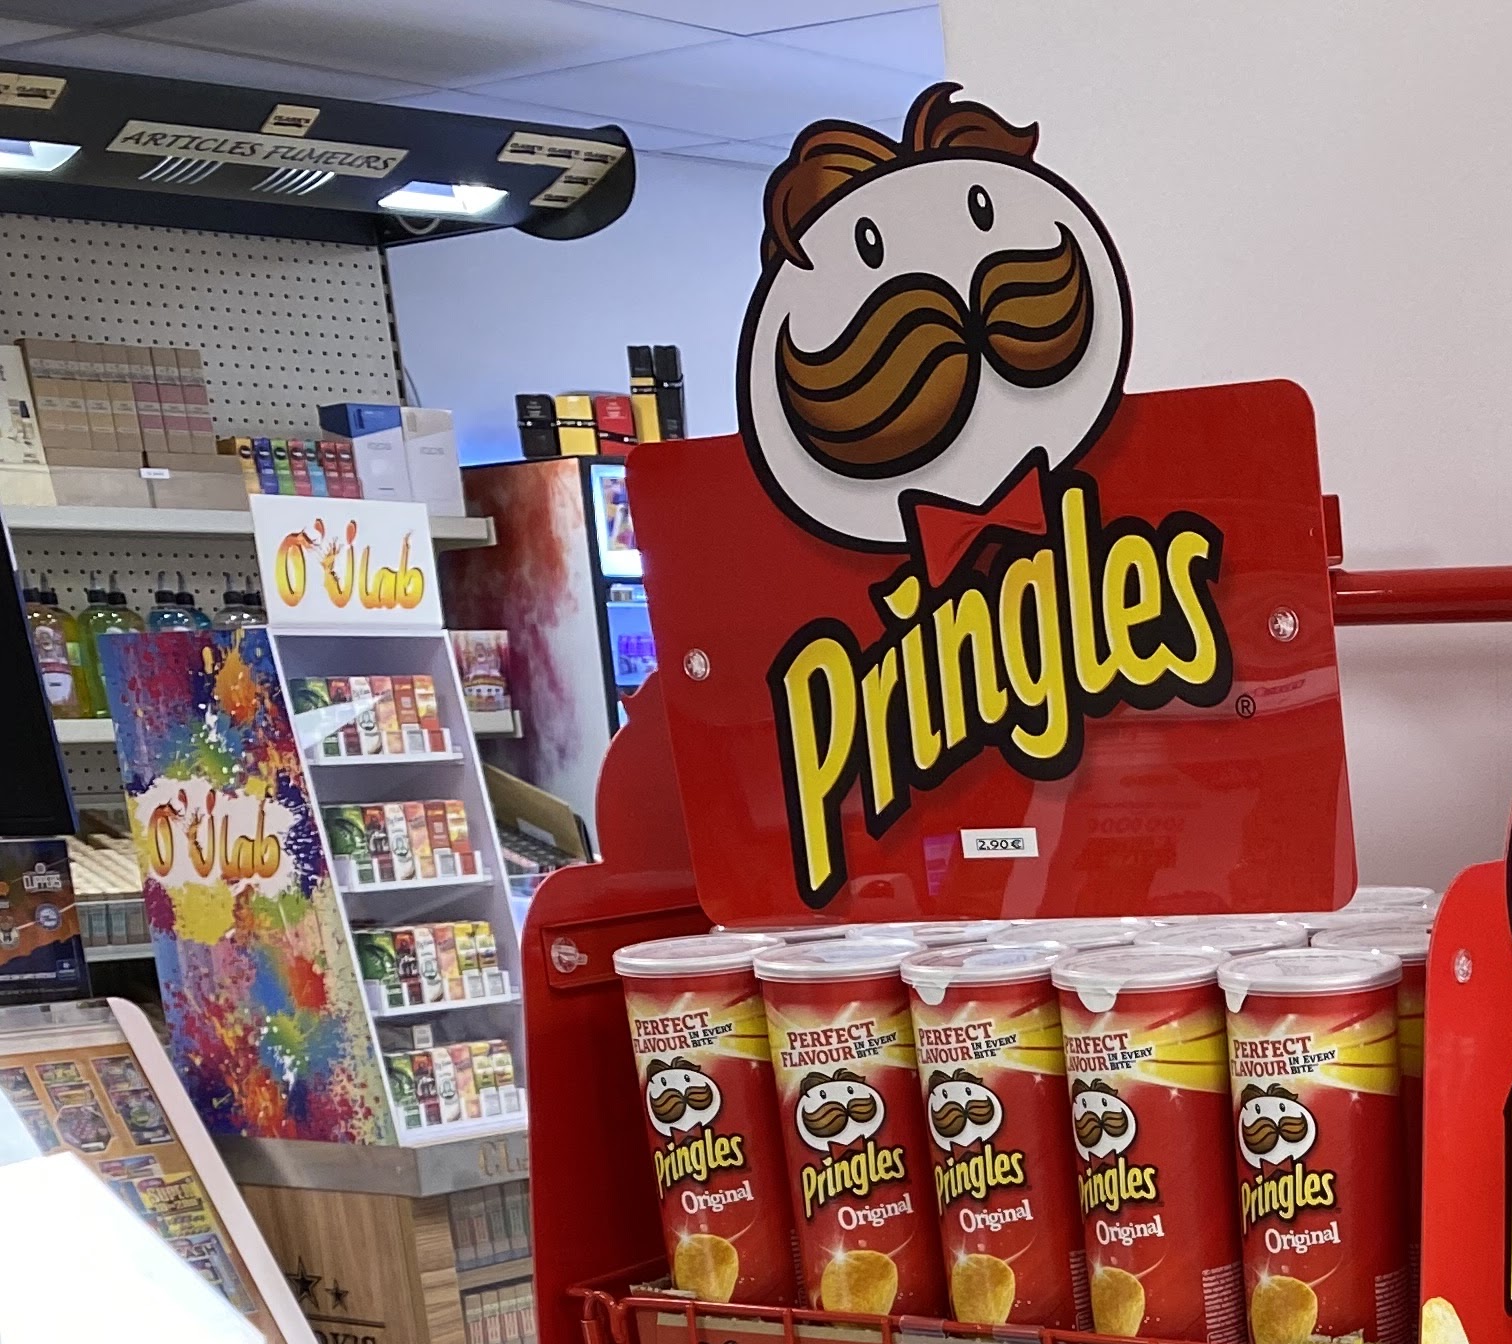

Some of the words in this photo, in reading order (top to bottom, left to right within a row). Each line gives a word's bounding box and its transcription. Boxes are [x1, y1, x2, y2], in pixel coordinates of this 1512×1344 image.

[121, 130, 257, 157] ARTICLES
[263, 143, 396, 171] FUMEURS
[780, 484, 1222, 897] Pringles
[781, 1047, 854, 1069] FLAVOUR
[867, 1032, 898, 1048] EVERY
[787, 1020, 876, 1050] PERFECT
[1234, 1036, 1312, 1058] PERFECT
[1301, 1050, 1336, 1064] EVERY
[654, 1127, 744, 1198] Pringles
[802, 1141, 906, 1219] Pringles
[934, 1141, 1025, 1217] Pringles
[681, 1180, 754, 1216] Original
[837, 1193, 915, 1231] Original
[959, 1198, 1034, 1234] Original
[1241, 1163, 1336, 1235] Pringles
[1096, 1215, 1165, 1247] Original
[1264, 1222, 1342, 1254] Original
